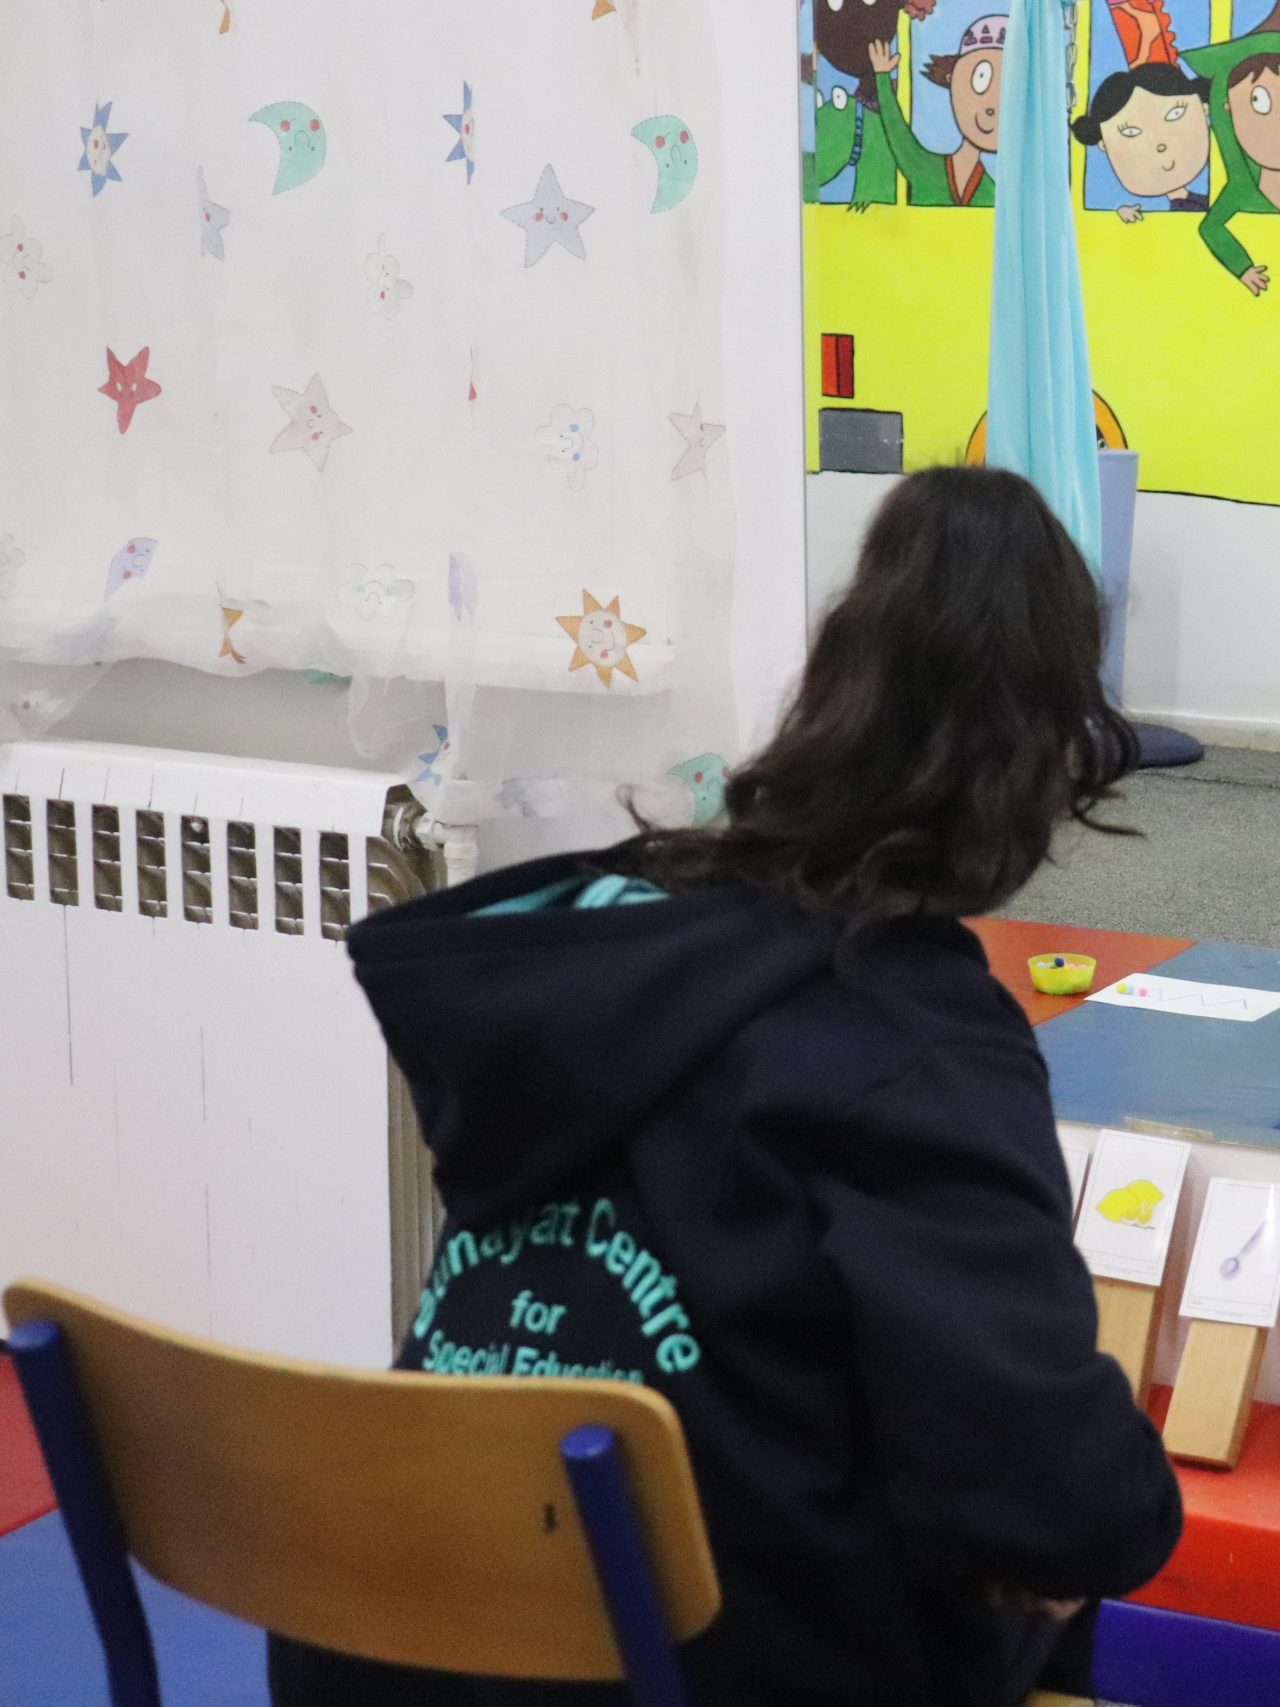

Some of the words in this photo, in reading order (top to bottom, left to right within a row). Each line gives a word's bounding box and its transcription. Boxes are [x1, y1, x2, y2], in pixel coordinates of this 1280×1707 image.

[585, 1197, 702, 1375] Centre
[509, 1289, 567, 1334] for
[422, 1329, 510, 1375] Special
